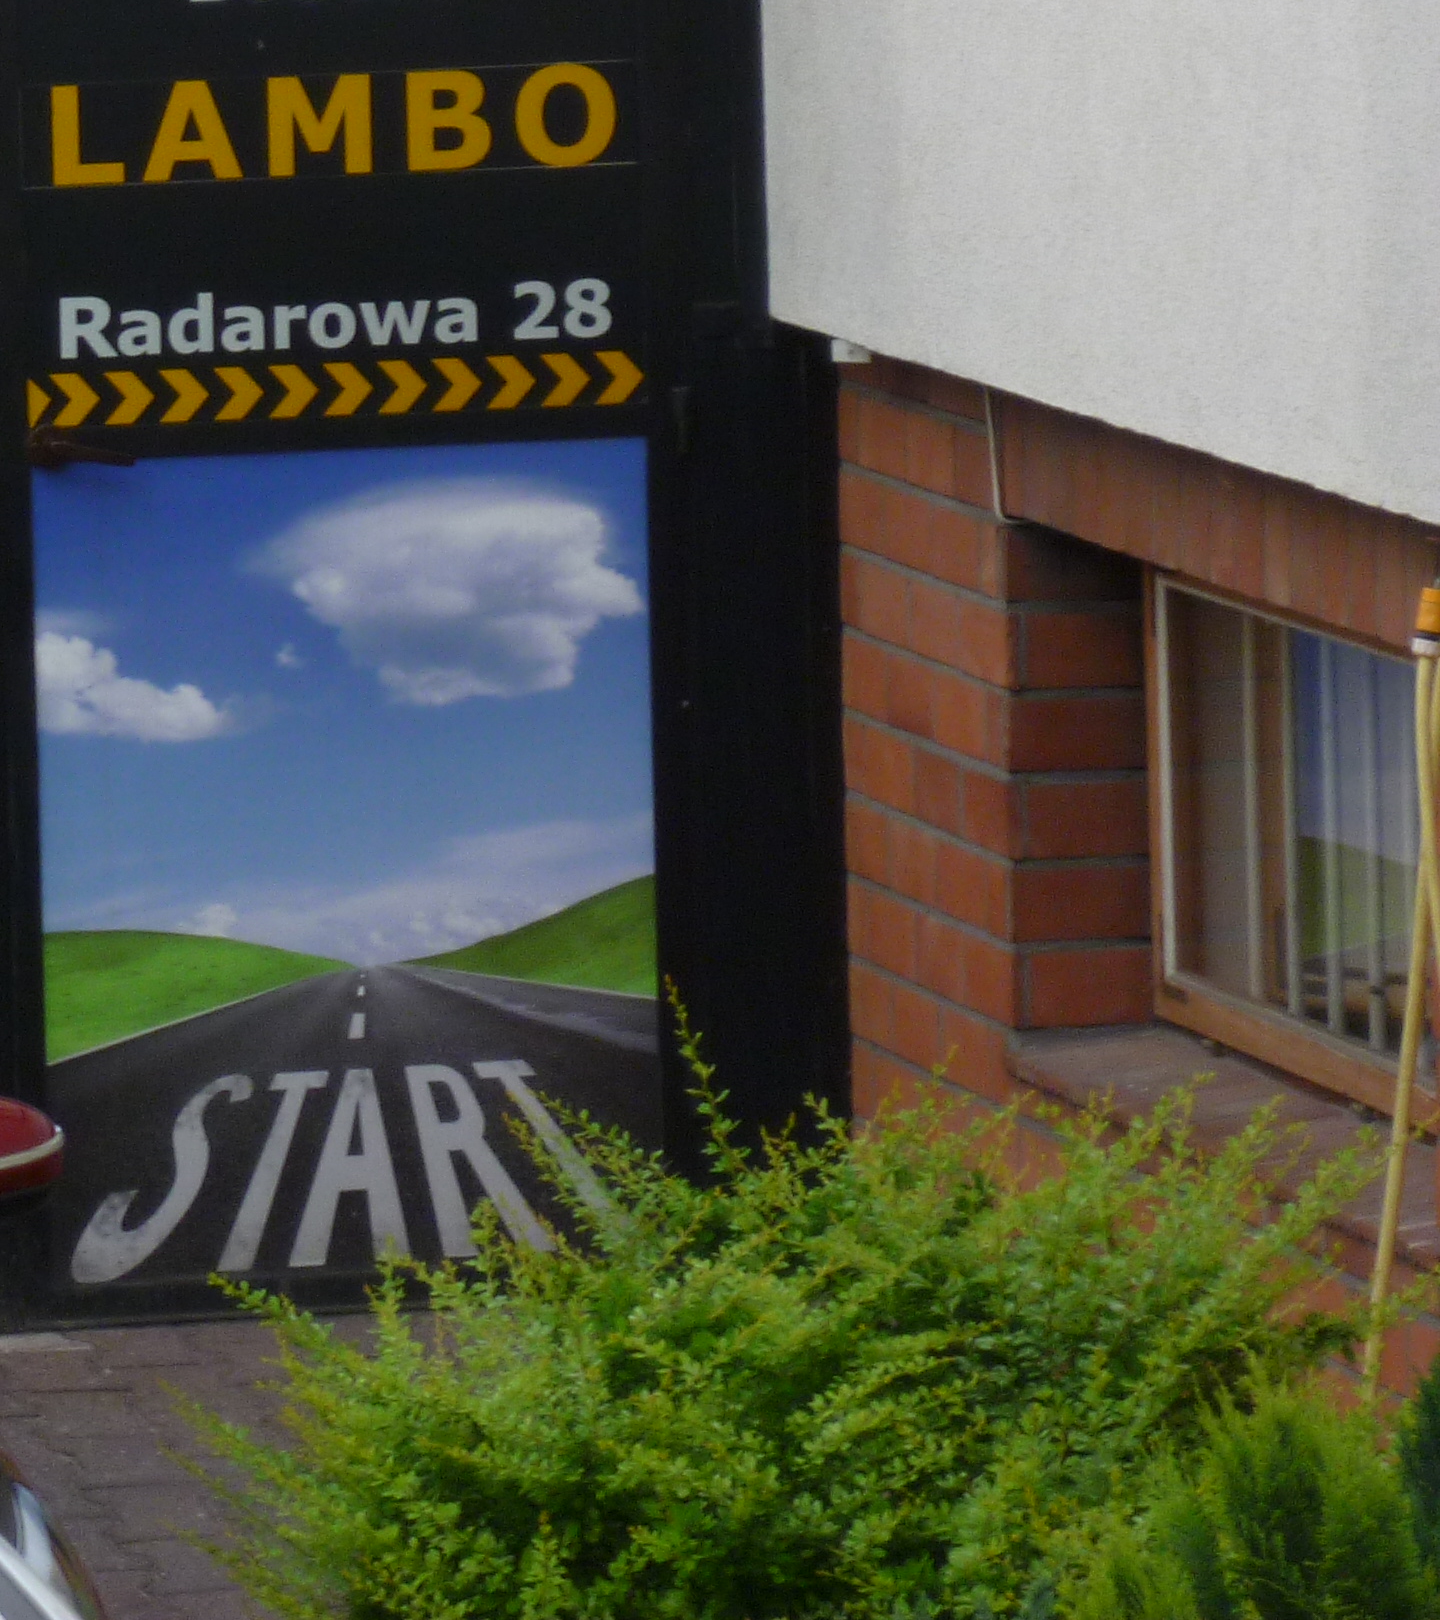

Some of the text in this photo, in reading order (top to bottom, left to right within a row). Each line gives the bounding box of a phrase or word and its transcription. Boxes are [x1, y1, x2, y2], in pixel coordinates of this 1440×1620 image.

[50, 61, 616, 187] LAMBO
[57, 278, 613, 360] Radarowa 28
[71, 1059, 620, 1284] START
